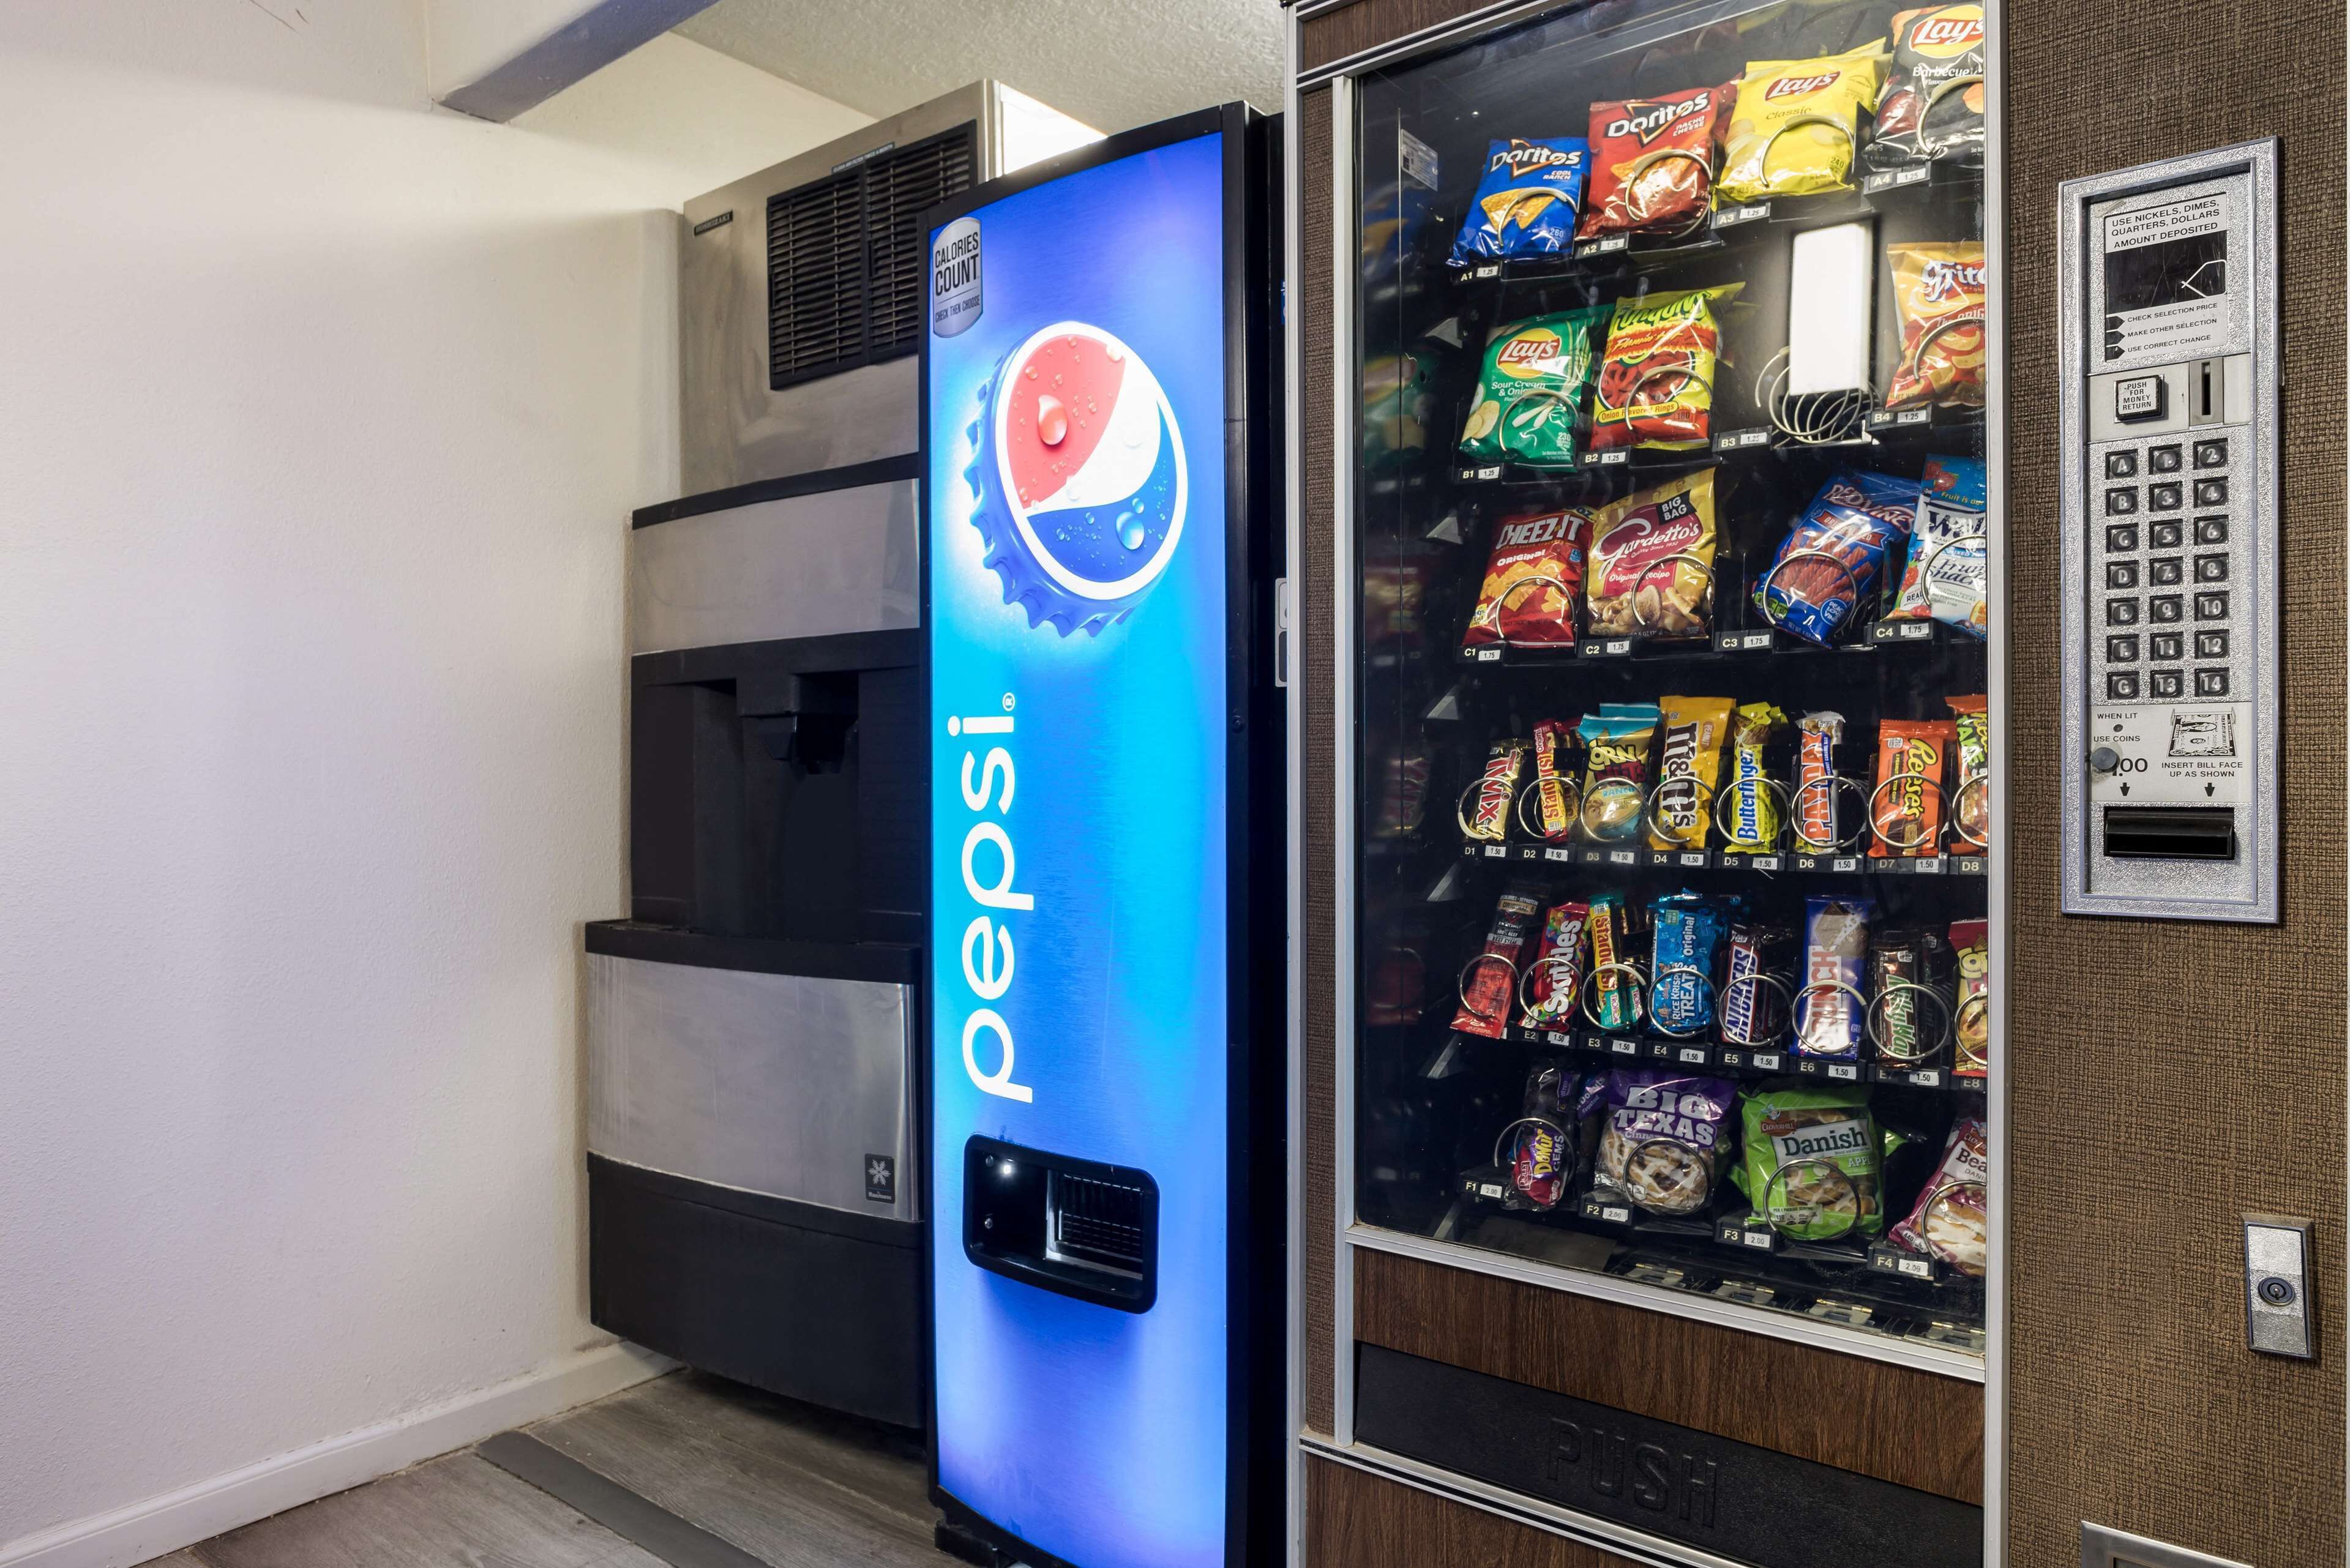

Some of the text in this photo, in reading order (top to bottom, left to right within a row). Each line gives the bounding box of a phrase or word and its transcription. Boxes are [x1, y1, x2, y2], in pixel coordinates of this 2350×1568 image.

[1913, 67, 1969, 77] Barbecue
[1607, 92, 1708, 139] Doritos
[1766, 106, 1811, 119] Classic
[1672, 122, 1704, 136] CHEESE
[1675, 115, 1705, 129] NACHO
[1490, 147, 1582, 171] Doritos
[1874, 176, 1890, 186] A4
[1719, 214, 1734, 223] A3
[2112, 199, 2220, 226] USE NICKELS, DIMES,
[2111, 209, 2220, 236] QUARTERS, DOLLARS
[1550, 228, 1563, 237] 260
[2114, 222, 2218, 248] AMOUNT DEPOSITED
[935, 232, 979, 268] CALORIES
[1583, 245, 1597, 255] A2
[935, 253, 979, 296] COUNT
[1461, 272, 1473, 281] A1
[935, 294, 980, 323] CHECK THEN CHOOSE
[2127, 303, 2218, 323] CHECK SELECTION PRICE
[2150, 325, 2174, 334] OTHER
[2176, 318, 2217, 330] SELECTION
[2144, 339, 2177, 350] CORRECT
[2179, 335, 2210, 345] CHANGE
[1491, 380, 1545, 390] Sour Cream
[2122, 401, 2151, 411] RETURN
[2123, 395, 2150, 403] MONEY
[1602, 411, 1619, 420] Onion
[1874, 413, 1890, 422] B4
[1558, 432, 1571, 441] 230
[2207, 448, 2217, 463] 2
[2117, 458, 2128, 473] A
[2162, 491, 2172, 505] 3
[2206, 487, 2217, 500] 4
[1661, 497, 1681, 512] BIG
[2119, 496, 2128, 510] B
[1664, 504, 1687, 521] BAG
[2119, 533, 2128, 545] C
[2163, 529, 2172, 542] 5
[2206, 525, 2217, 539] 6
[1588, 518, 1699, 579] Gardetto's
[1609, 571, 1640, 583] Original
[2118, 570, 2128, 583] D
[2163, 566, 2172, 580] 7
[2206, 563, 2217, 577] 8
[2119, 606, 2128, 620] E
[2162, 603, 2172, 618] 9
[2204, 600, 2221, 614] 10
[1876, 628, 1893, 637] C4
[1586, 646, 1600, 654] C2
[1723, 639, 1737, 648] C3
[2120, 643, 2128, 657] F
[2159, 641, 2175, 655] 11
[2204, 639, 2221, 653] 12
[1464, 647, 1475, 656] C1
[2119, 680, 2130, 694] G
[2158, 679, 2176, 692] 13
[2204, 677, 2221, 691] 14
[1701, 725, 1713, 747] PEANUT
[1588, 739, 1637, 771] CORN
[1476, 750, 1517, 823] TWIX
[1737, 750, 1759, 840] Butterfinger
[1800, 859, 1814, 868] D6
[1962, 862, 1978, 871] D8
[948, 715, 1033, 1103] pepsi
[1683, 917, 1695, 956] original
[1544, 920, 1582, 1014] Skittles
[1672, 1000, 1682, 1020] RICE
[1554, 1034, 1565, 1042] 1.50
[1654, 1047, 1697, 1061] E4 1.50
[1725, 1054, 1738, 1062] E5
[1800, 1064, 1814, 1072] E6
[1626, 1087, 1710, 1121] BIG
[1615, 1109, 1713, 1146] TEXAS
[1781, 1127, 1866, 1156] Danish
[1553, 1135, 1564, 1171] GEMS
[1587, 1206, 1599, 1215] F2
[1724, 1231, 1738, 1240] F3
[1877, 1257, 1893, 1267] F4
[1546, 1417, 1716, 1527] PUSH
